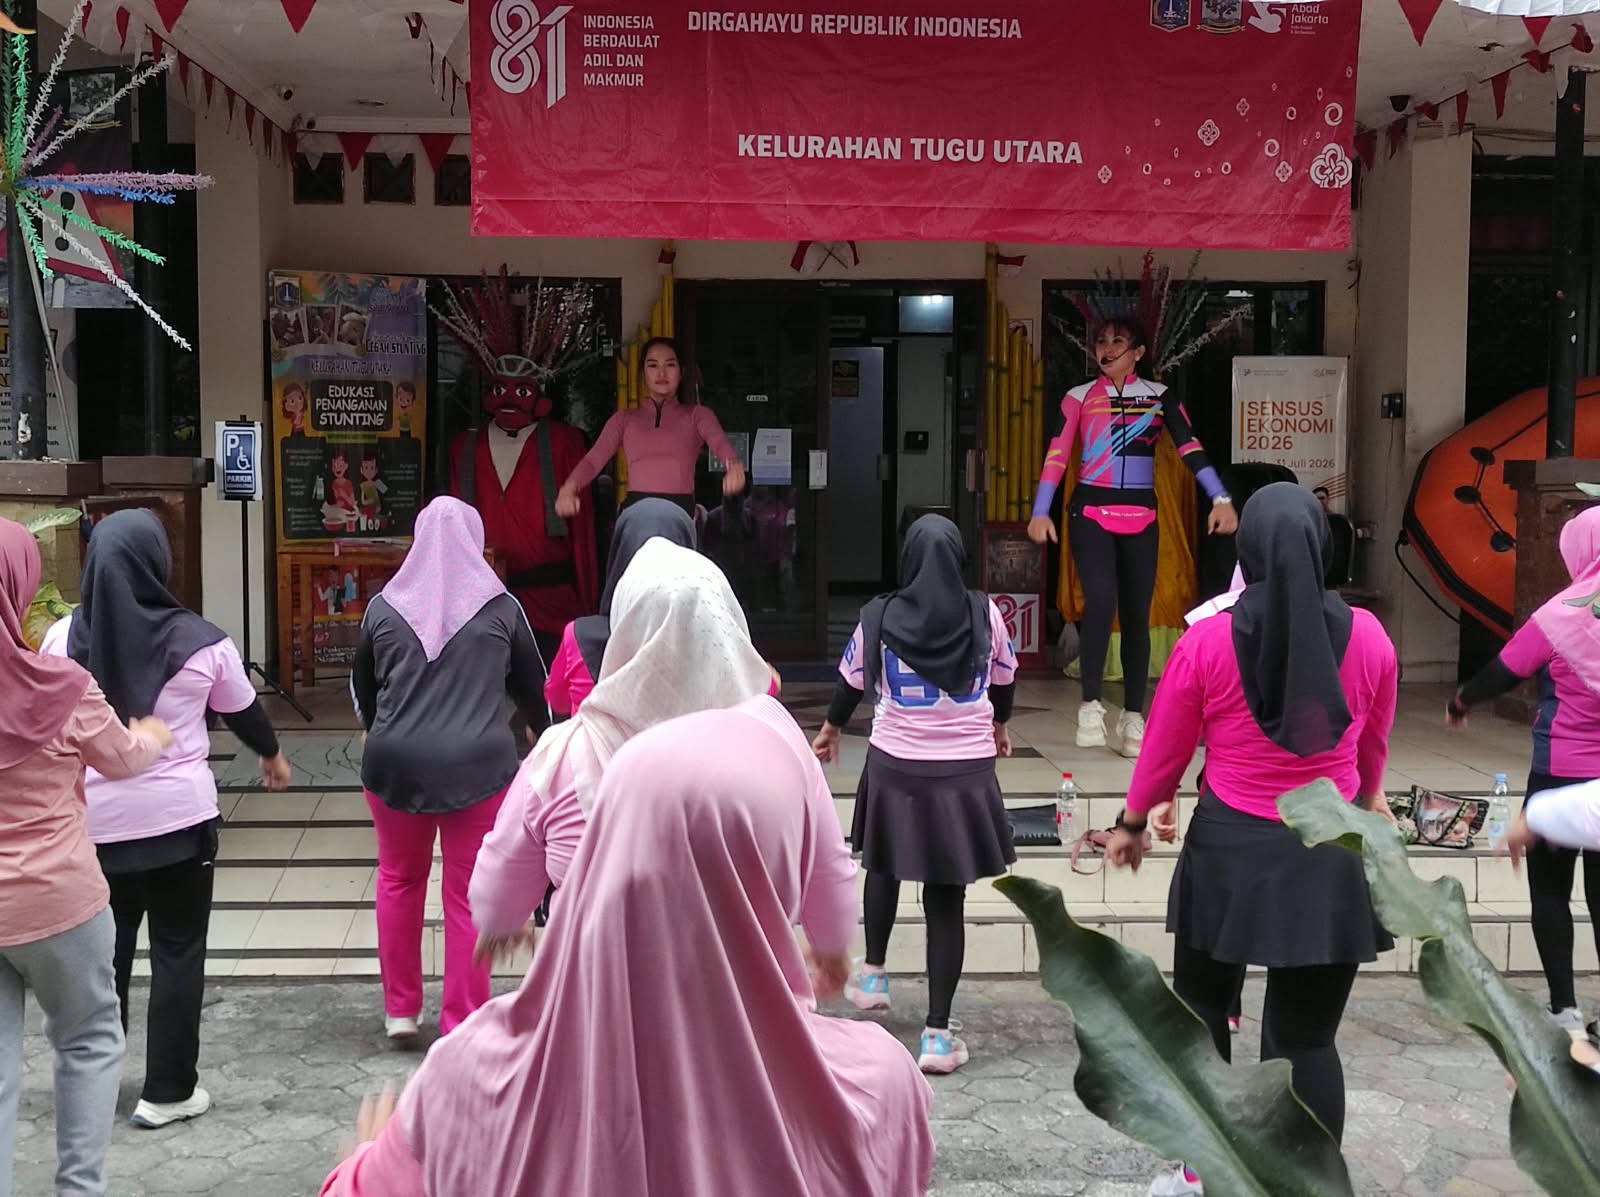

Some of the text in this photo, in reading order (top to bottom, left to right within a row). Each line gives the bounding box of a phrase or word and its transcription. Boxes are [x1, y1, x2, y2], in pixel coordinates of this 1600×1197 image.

[1291, 3, 1320, 14] Abad
[583, 14, 655, 29] INDONESIA
[688, 11, 1022, 39] DIRGAHAYU REPUBLIK INDONESIA
[1291, 13, 1329, 25] Jakarta
[583, 34, 660, 48] BERDAULAT
[490, 0, 574, 109] 81
[583, 53, 644, 68] ADIL DAN
[583, 72, 644, 87] MAKMUR
[738, 133, 1083, 164] KELURAHAN TUGU UTARA
[328, 385, 375, 398] EDUKASI
[315, 398, 388, 411] PENANGANAN
[1247, 401, 1323, 416] SENSUS
[319, 412, 384, 426] STUNTING
[1247, 418, 1333, 433] EKONOMI
[226, 434, 240, 457] P
[1247, 435, 1293, 450] 2026
[1288, 458, 1306, 468] Juli
[1308, 458, 1335, 468] 2026
